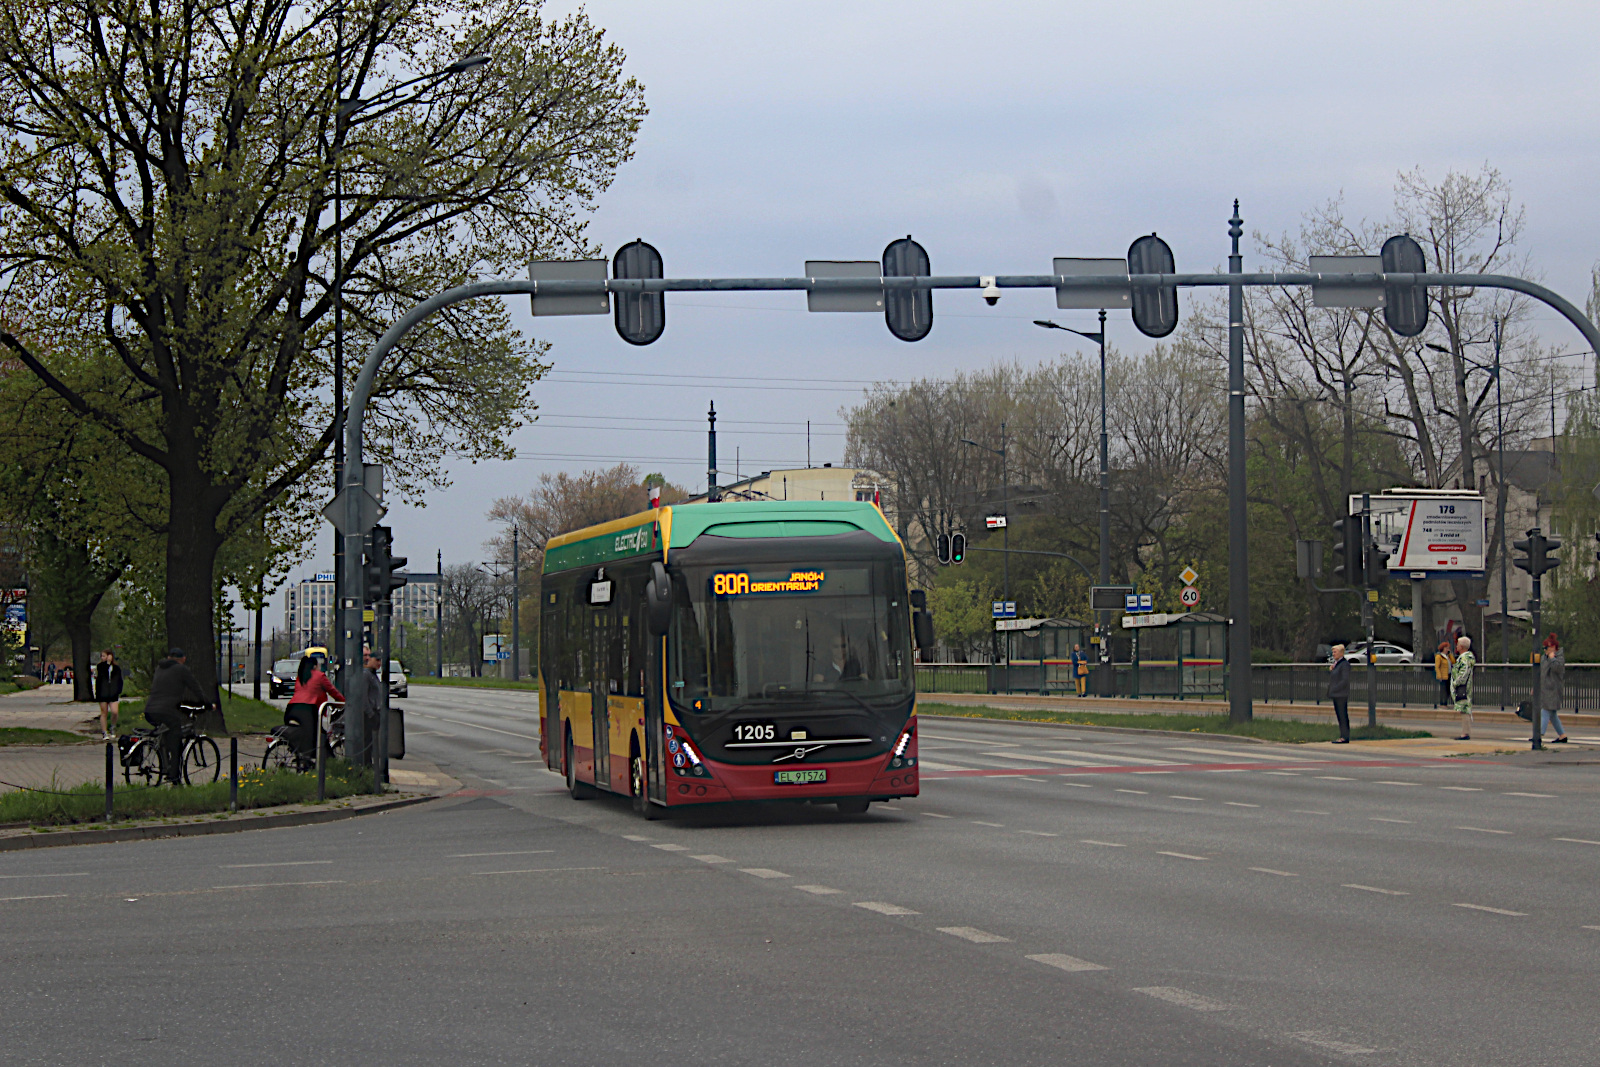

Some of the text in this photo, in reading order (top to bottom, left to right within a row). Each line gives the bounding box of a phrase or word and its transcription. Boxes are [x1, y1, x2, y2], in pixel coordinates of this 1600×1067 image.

[1439, 505, 1455, 514] 178
[789, 571, 824, 582] JANÓW
[714, 573, 749, 594] 80A
[750, 581, 818, 592] ORIENTARIUM
[1183, 591, 1197, 601] 60
[695, 700, 702, 709] 4
[735, 725, 774, 740] 1205
[780, 773, 792, 782] EL
[796, 771, 824, 781] 9T576
